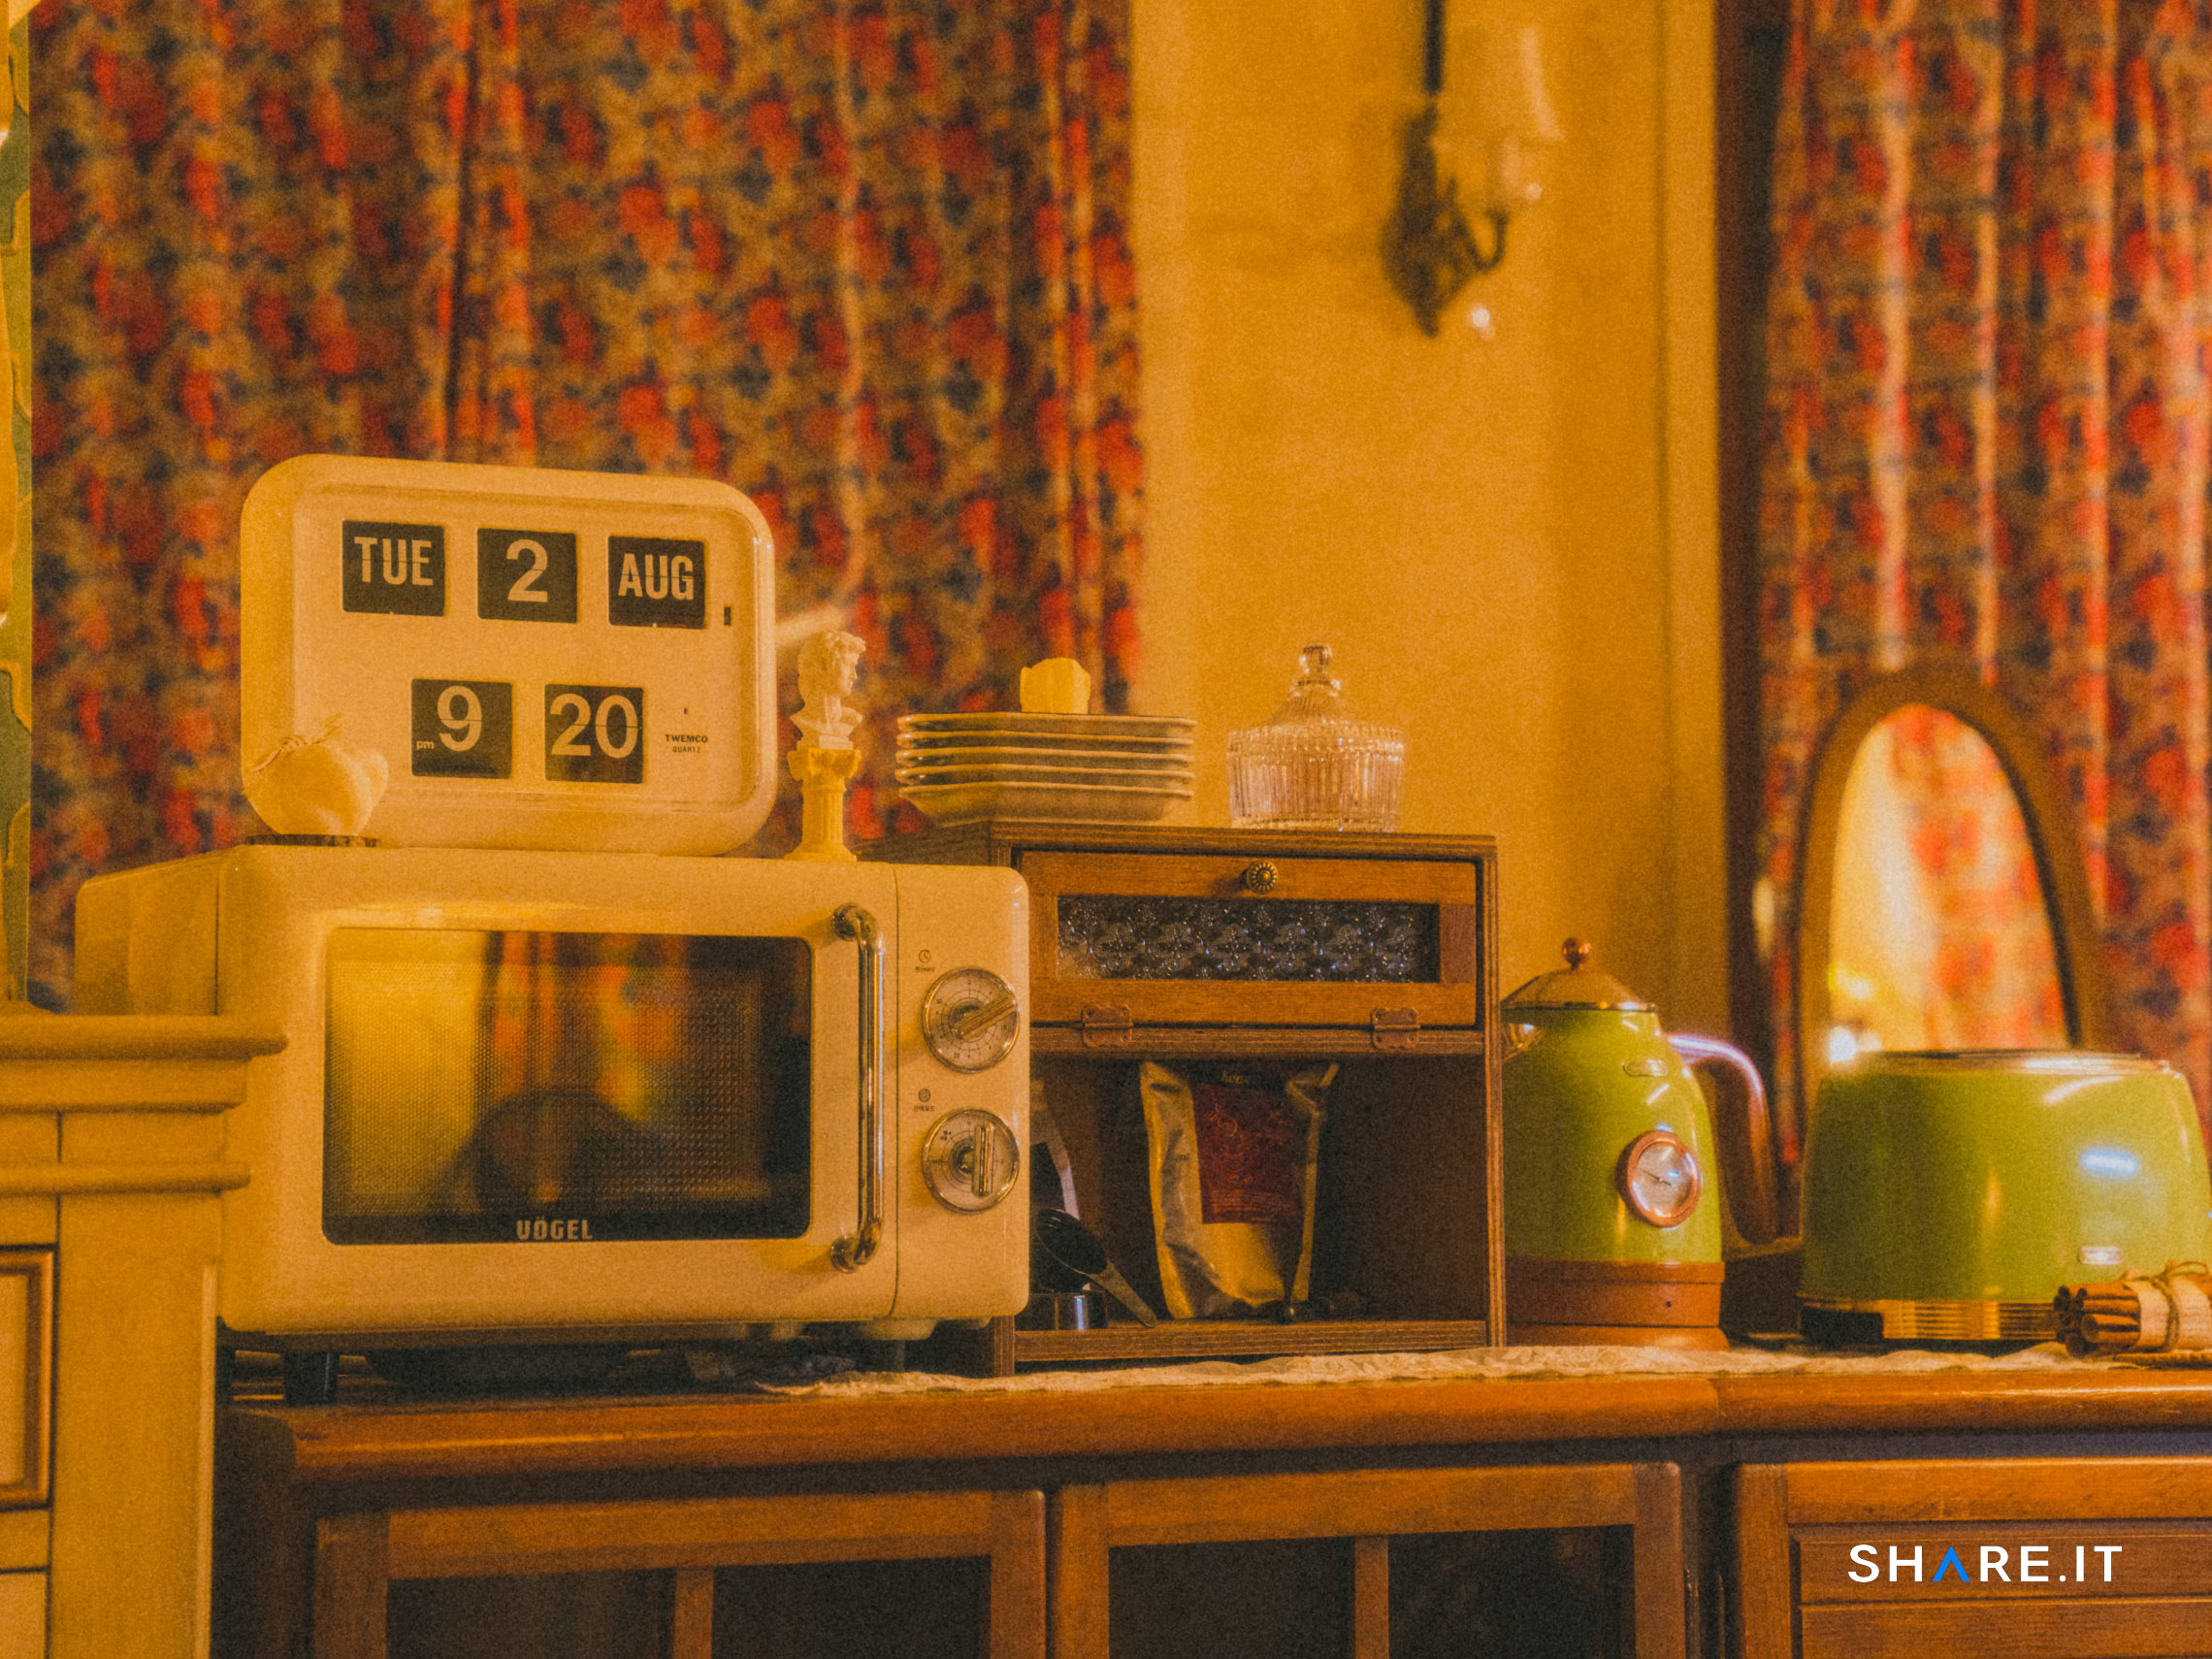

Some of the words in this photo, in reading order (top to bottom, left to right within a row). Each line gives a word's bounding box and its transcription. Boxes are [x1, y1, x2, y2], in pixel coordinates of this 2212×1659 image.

[353, 536, 434, 586] TUE
[505, 538, 548, 603] 2
[618, 552, 695, 601] AUG
[415, 739, 435, 751] pm
[437, 685, 483, 752] 9
[549, 693, 638, 759] 20
[665, 733, 708, 743] TWEMCO
